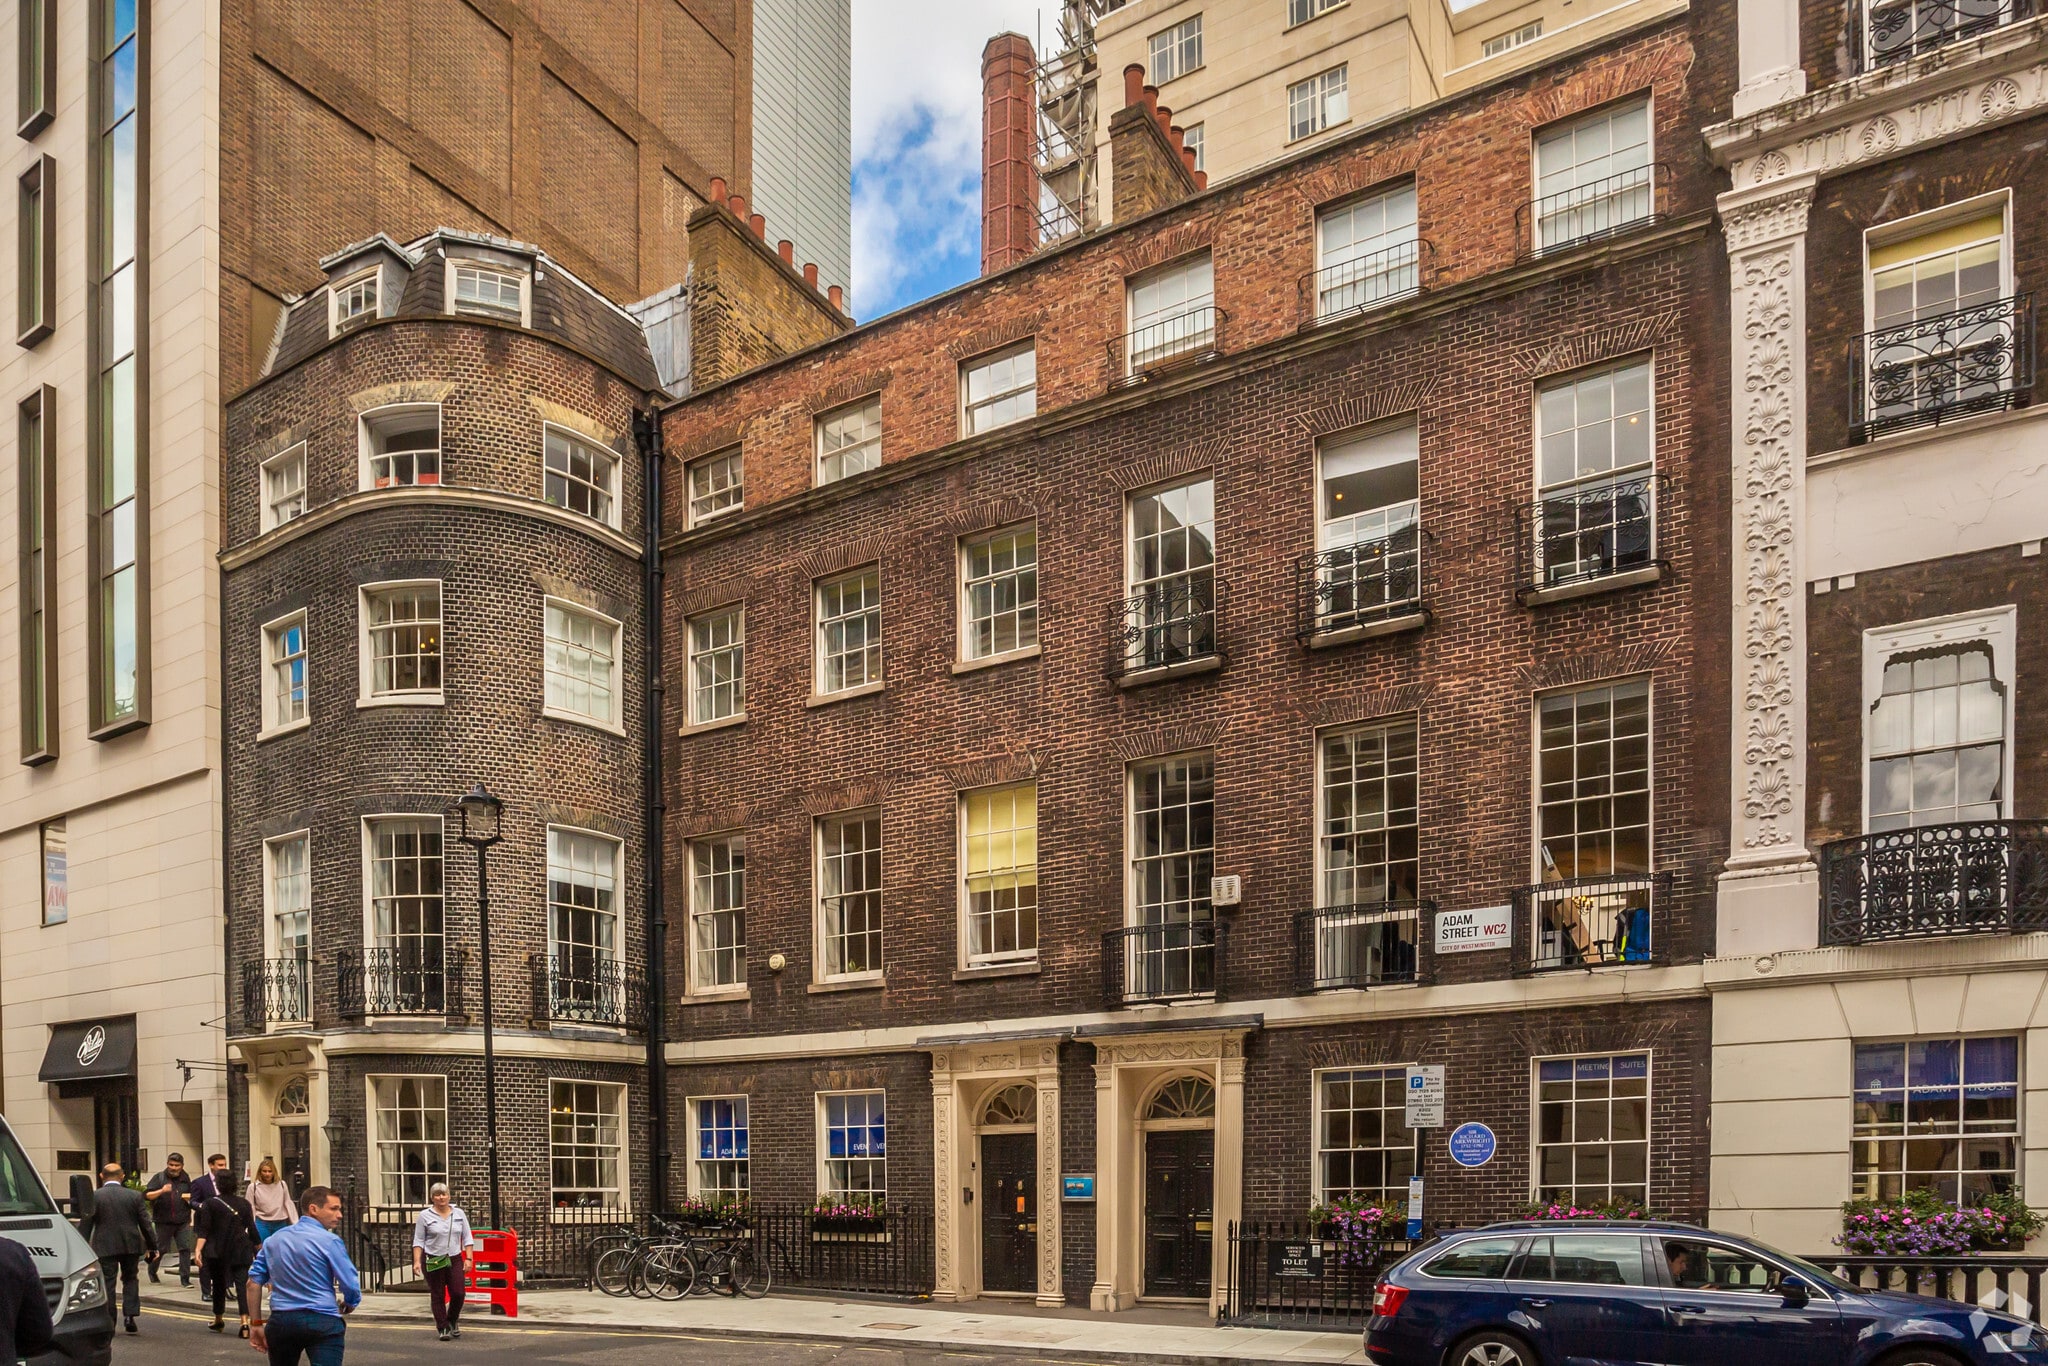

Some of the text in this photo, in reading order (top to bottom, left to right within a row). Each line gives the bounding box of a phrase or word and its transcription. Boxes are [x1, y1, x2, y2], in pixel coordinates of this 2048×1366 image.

[1442, 914, 1473, 927] ADAM
[1442, 924, 1507, 939] STREET WC2
[1461, 941, 1496, 950] WESTMINSTER
[1620, 1060, 1646, 1069] SUITES
[27, 1246, 58, 1257] IRE
[1293, 1258, 1308, 1266] LET
